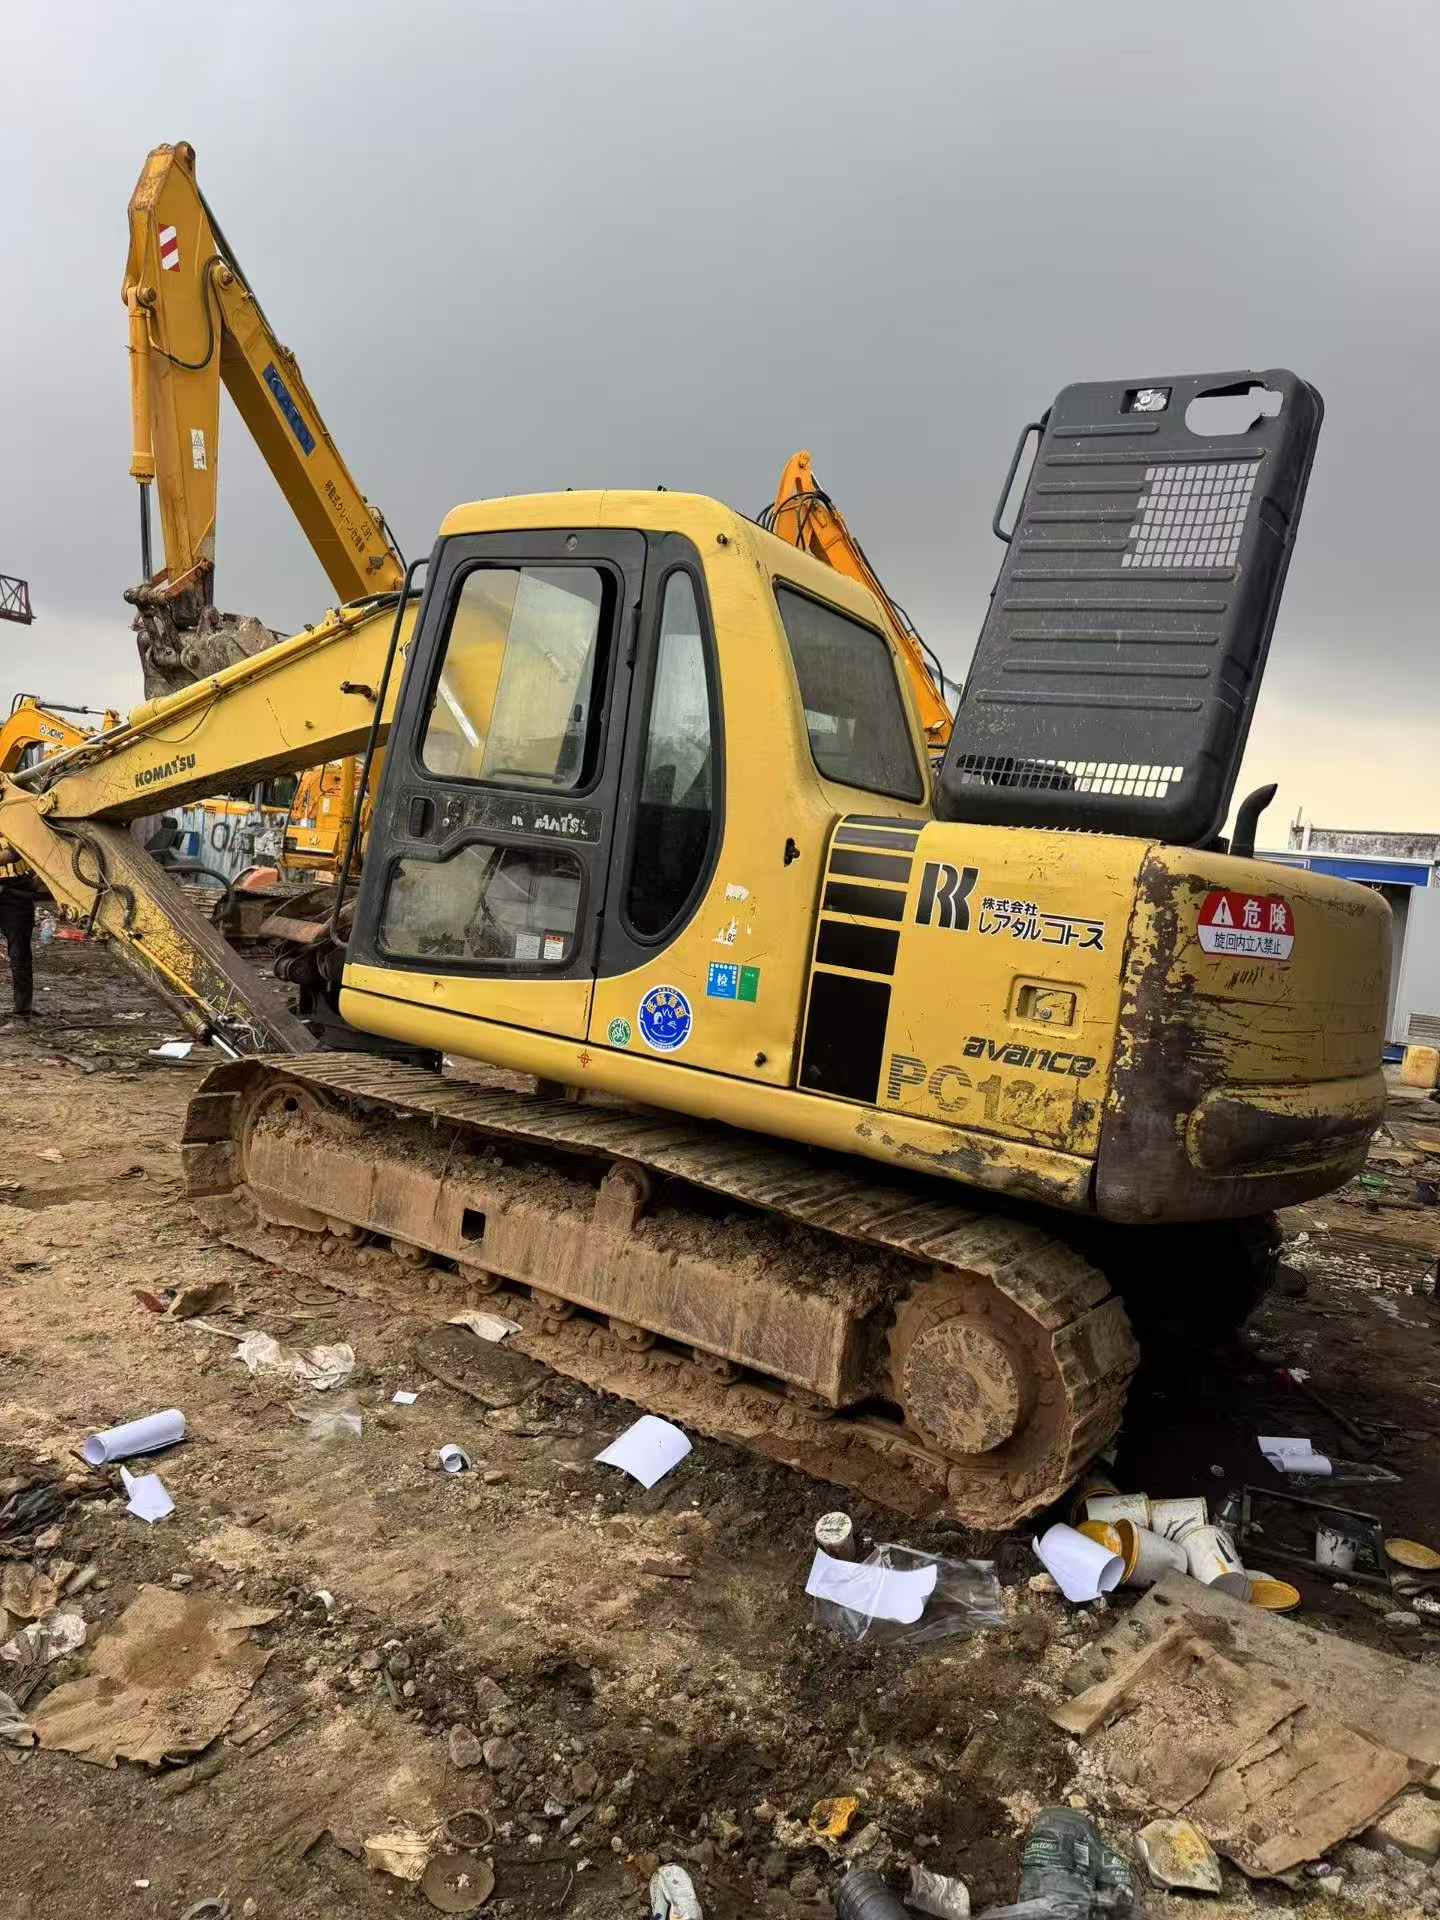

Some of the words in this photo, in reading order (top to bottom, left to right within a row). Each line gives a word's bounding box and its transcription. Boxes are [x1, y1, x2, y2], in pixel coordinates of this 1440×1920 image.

[135, 754, 196, 787] KOMATSU
[982, 897, 1038, 916] 株式会社
[1243, 899, 1287, 932] 危険
[1214, 931, 1281, 955] 旋回内立入禁止
[963, 1036, 1097, 1078] avance
